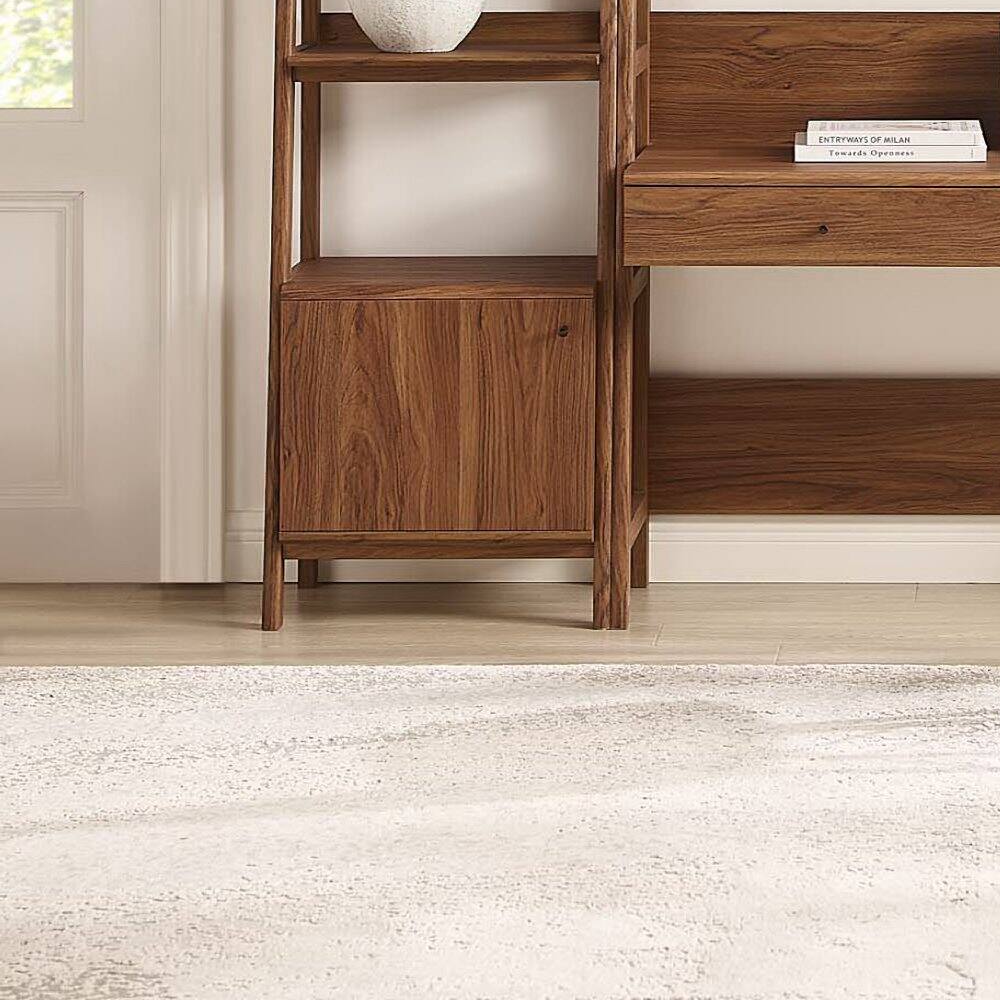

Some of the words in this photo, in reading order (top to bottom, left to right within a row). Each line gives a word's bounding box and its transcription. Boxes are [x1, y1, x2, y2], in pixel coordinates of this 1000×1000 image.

[818, 136, 869, 144] ENTRYWAYS
[870, 136, 882, 144] OF
[883, 136, 911, 144] MILAN
[829, 149, 867, 157] Towards
[870, 149, 915, 159] Openness
